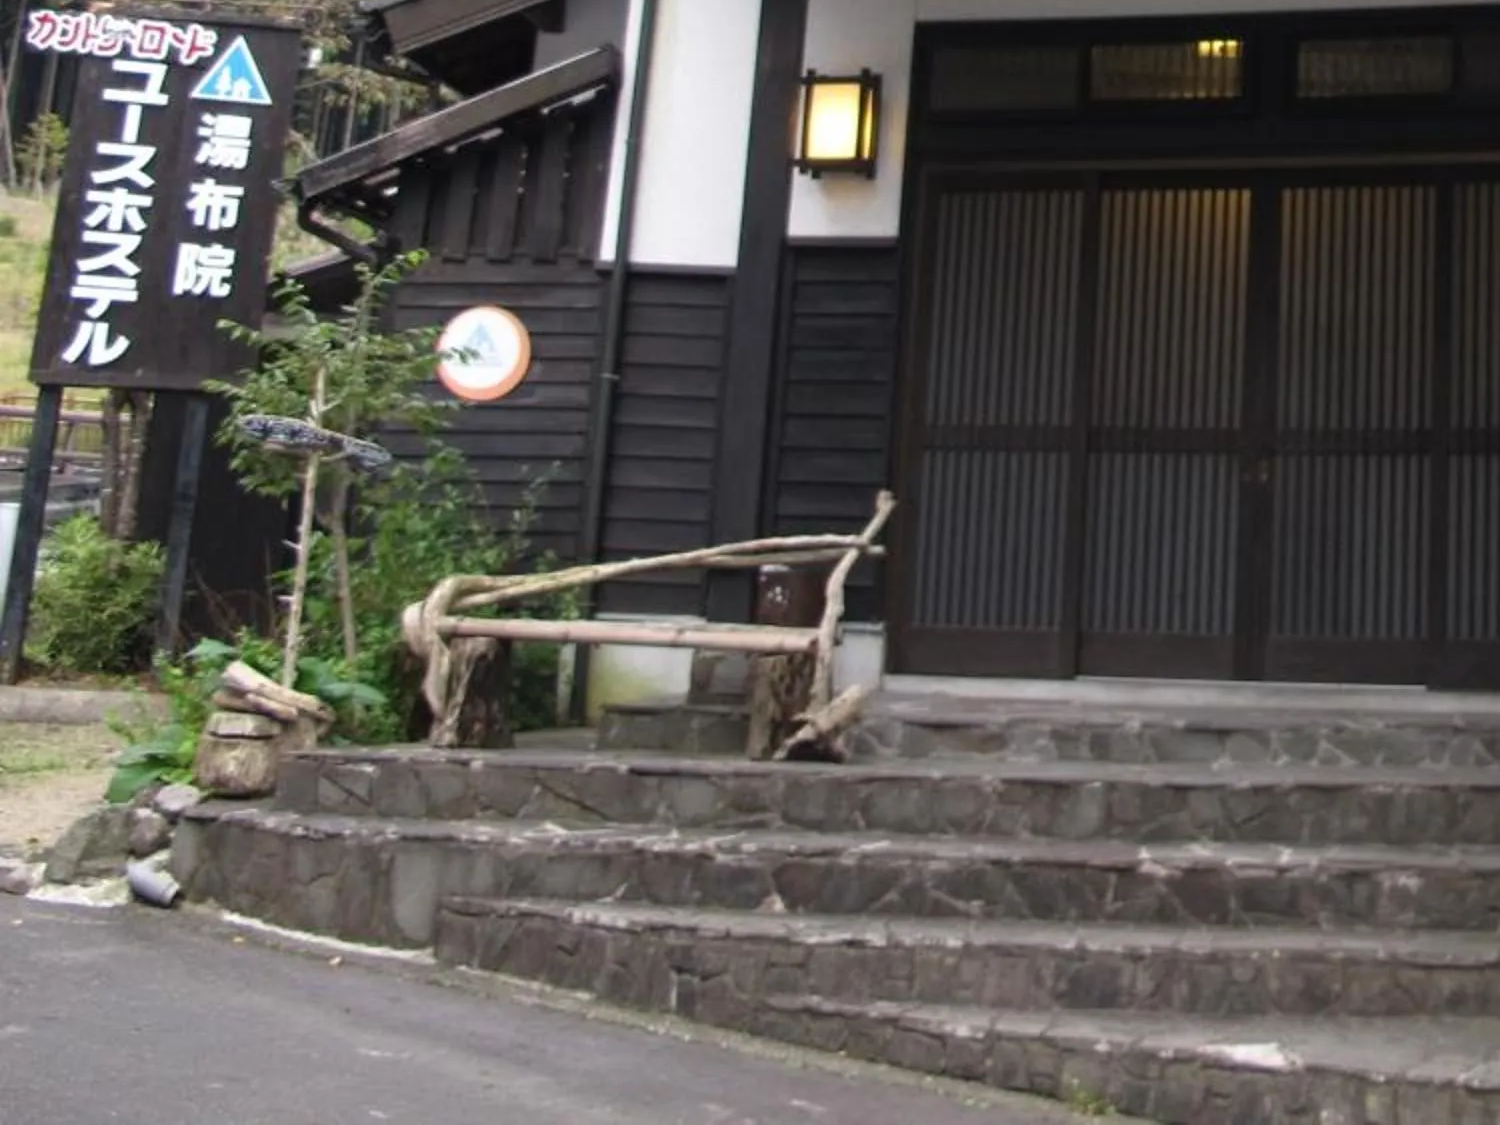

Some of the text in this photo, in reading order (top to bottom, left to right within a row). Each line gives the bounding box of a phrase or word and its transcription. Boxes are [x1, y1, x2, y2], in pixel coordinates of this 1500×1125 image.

[62, 59, 169, 366] ユースホステル
[172, 113, 252, 298] 湯布院
